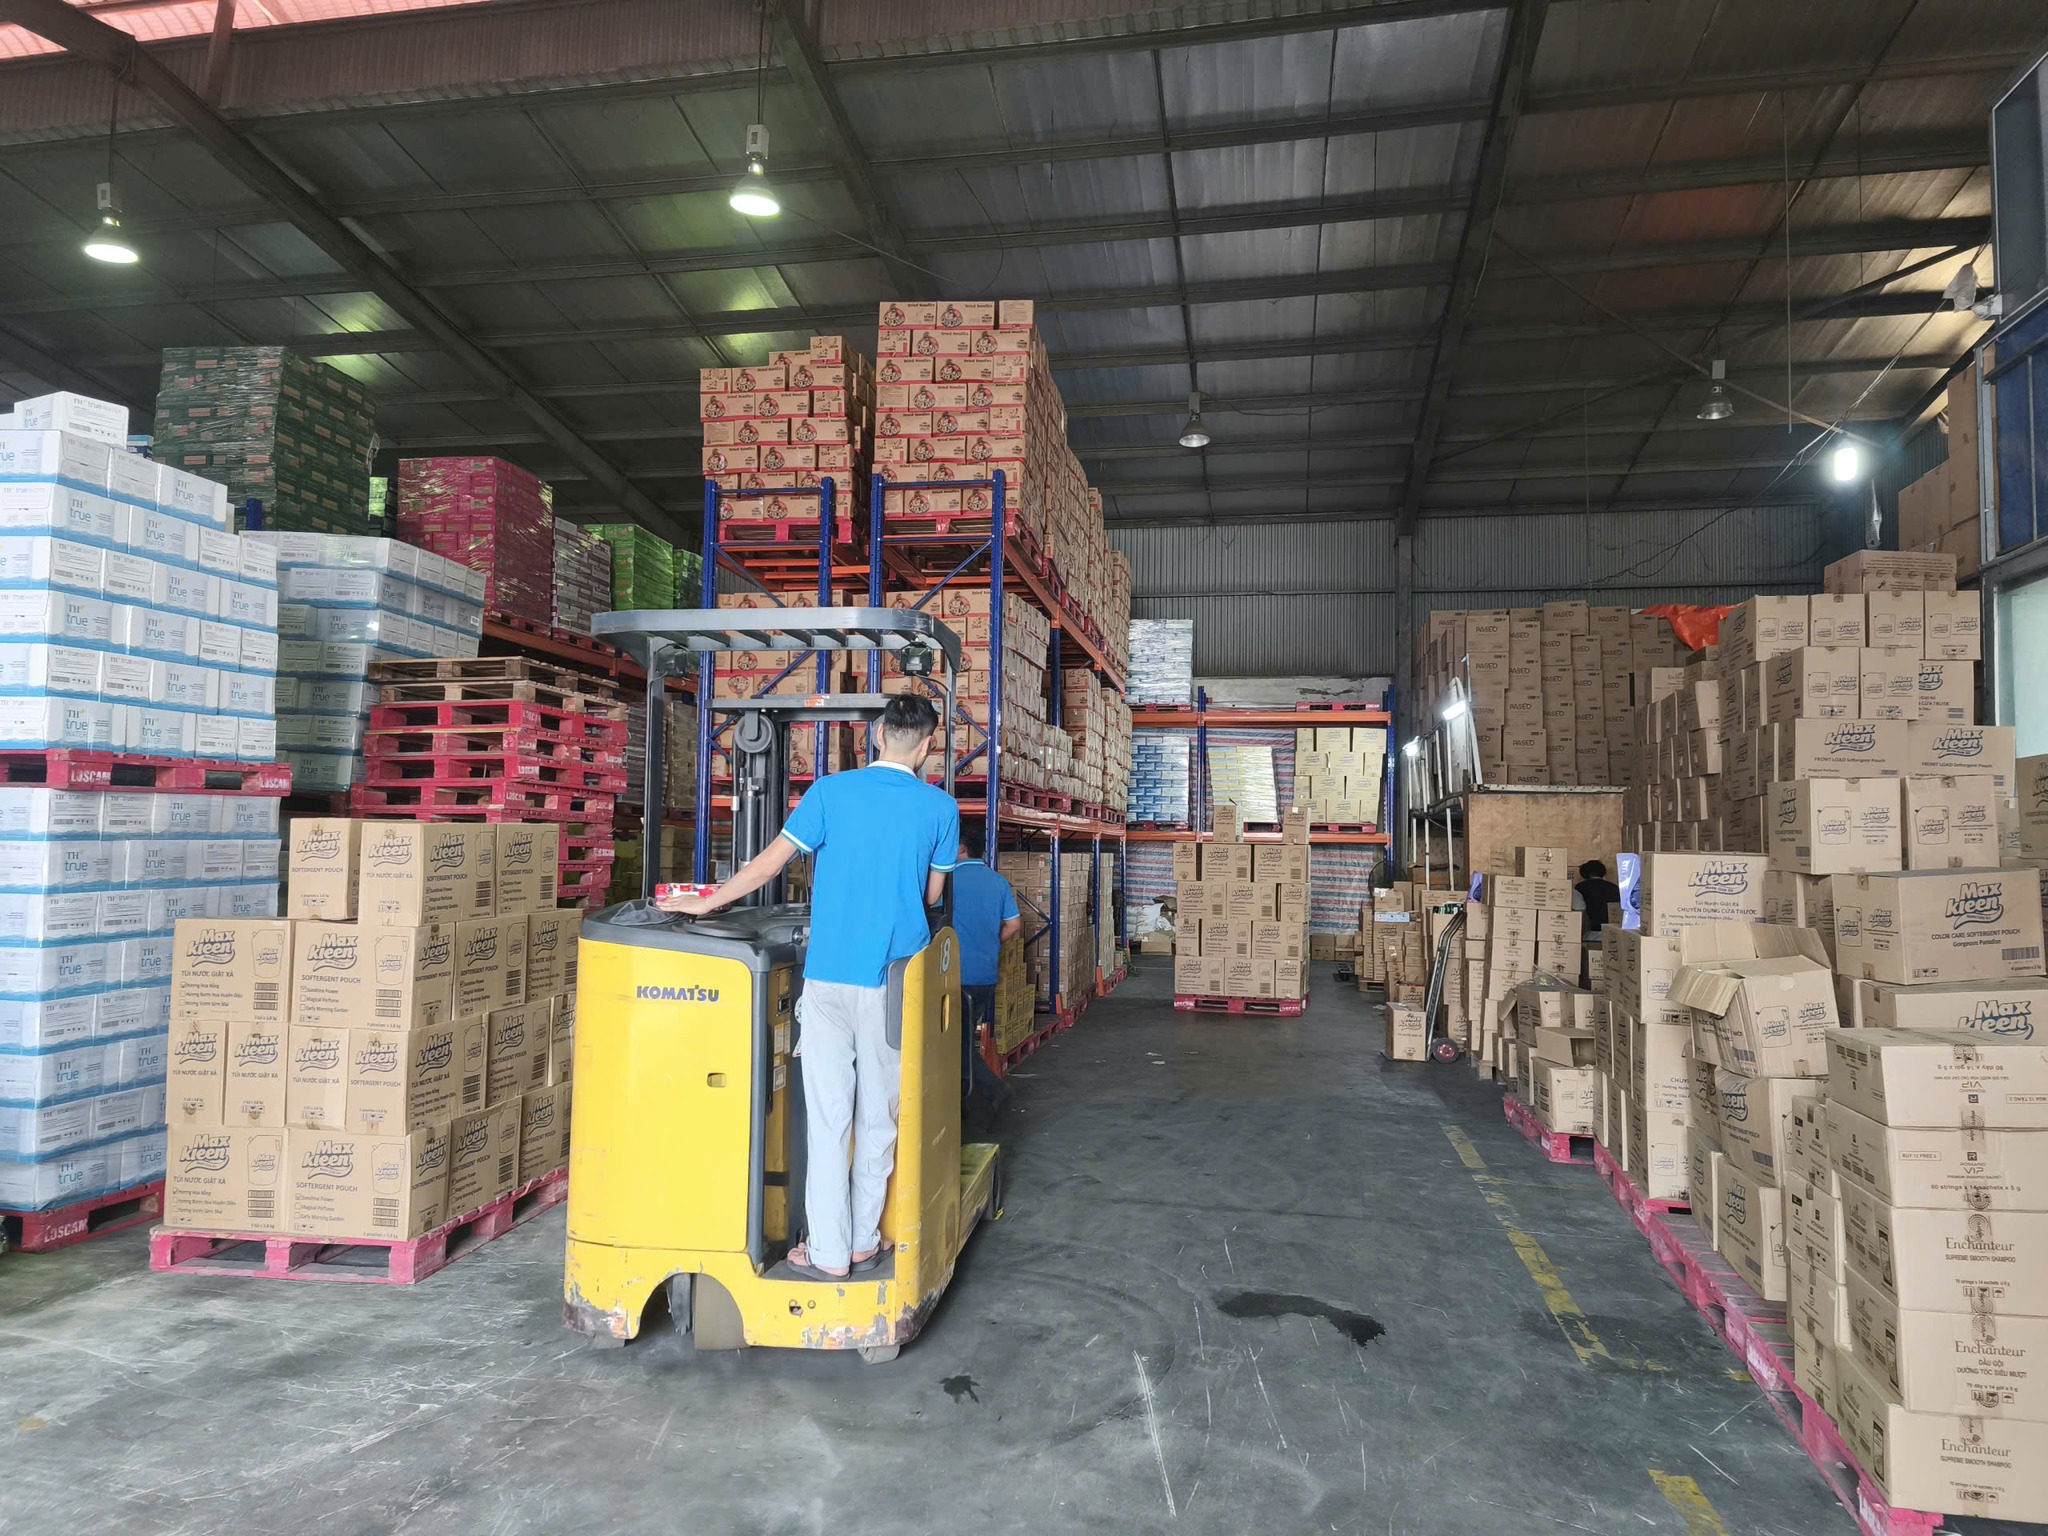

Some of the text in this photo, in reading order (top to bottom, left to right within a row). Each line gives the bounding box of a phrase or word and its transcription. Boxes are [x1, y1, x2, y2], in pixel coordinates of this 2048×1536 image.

[70, 508, 91, 522] true
[169, 586, 187, 597] true
[67, 615, 87, 626] true
[167, 681, 186, 693] true
[66, 720, 88, 730] true
[1839, 723, 1875, 734] Max
[142, 727, 162, 737] true
[1946, 728, 1983, 739] Max
[309, 830, 340, 841] Max
[439, 833, 464, 846] Max
[64, 861, 87, 871] true
[1704, 861, 1747, 873] Max
[1960, 882, 2001, 900] Max
[200, 929, 235, 943] Max
[321, 933, 358, 947] Max
[474, 927, 498, 941] Max
[58, 964, 82, 975] true
[636, 985, 719, 1002] KOMATSU
[1975, 1000, 2031, 1018] Max
[187, 1031, 216, 1044] Max
[368, 1041, 398, 1052] Max
[56, 1071, 79, 1081] true
[194, 1134, 230, 1148] Max
[316, 1140, 354, 1154] Max
[58, 1171, 83, 1183] true
[296, 1182, 357, 1192] SOFTERGENT POUCH
[1946, 1235, 2014, 1251] Enchanteur
[1955, 1339, 2026, 1357] Enchanteur
[1942, 1438, 2011, 1456] Enchanteur
